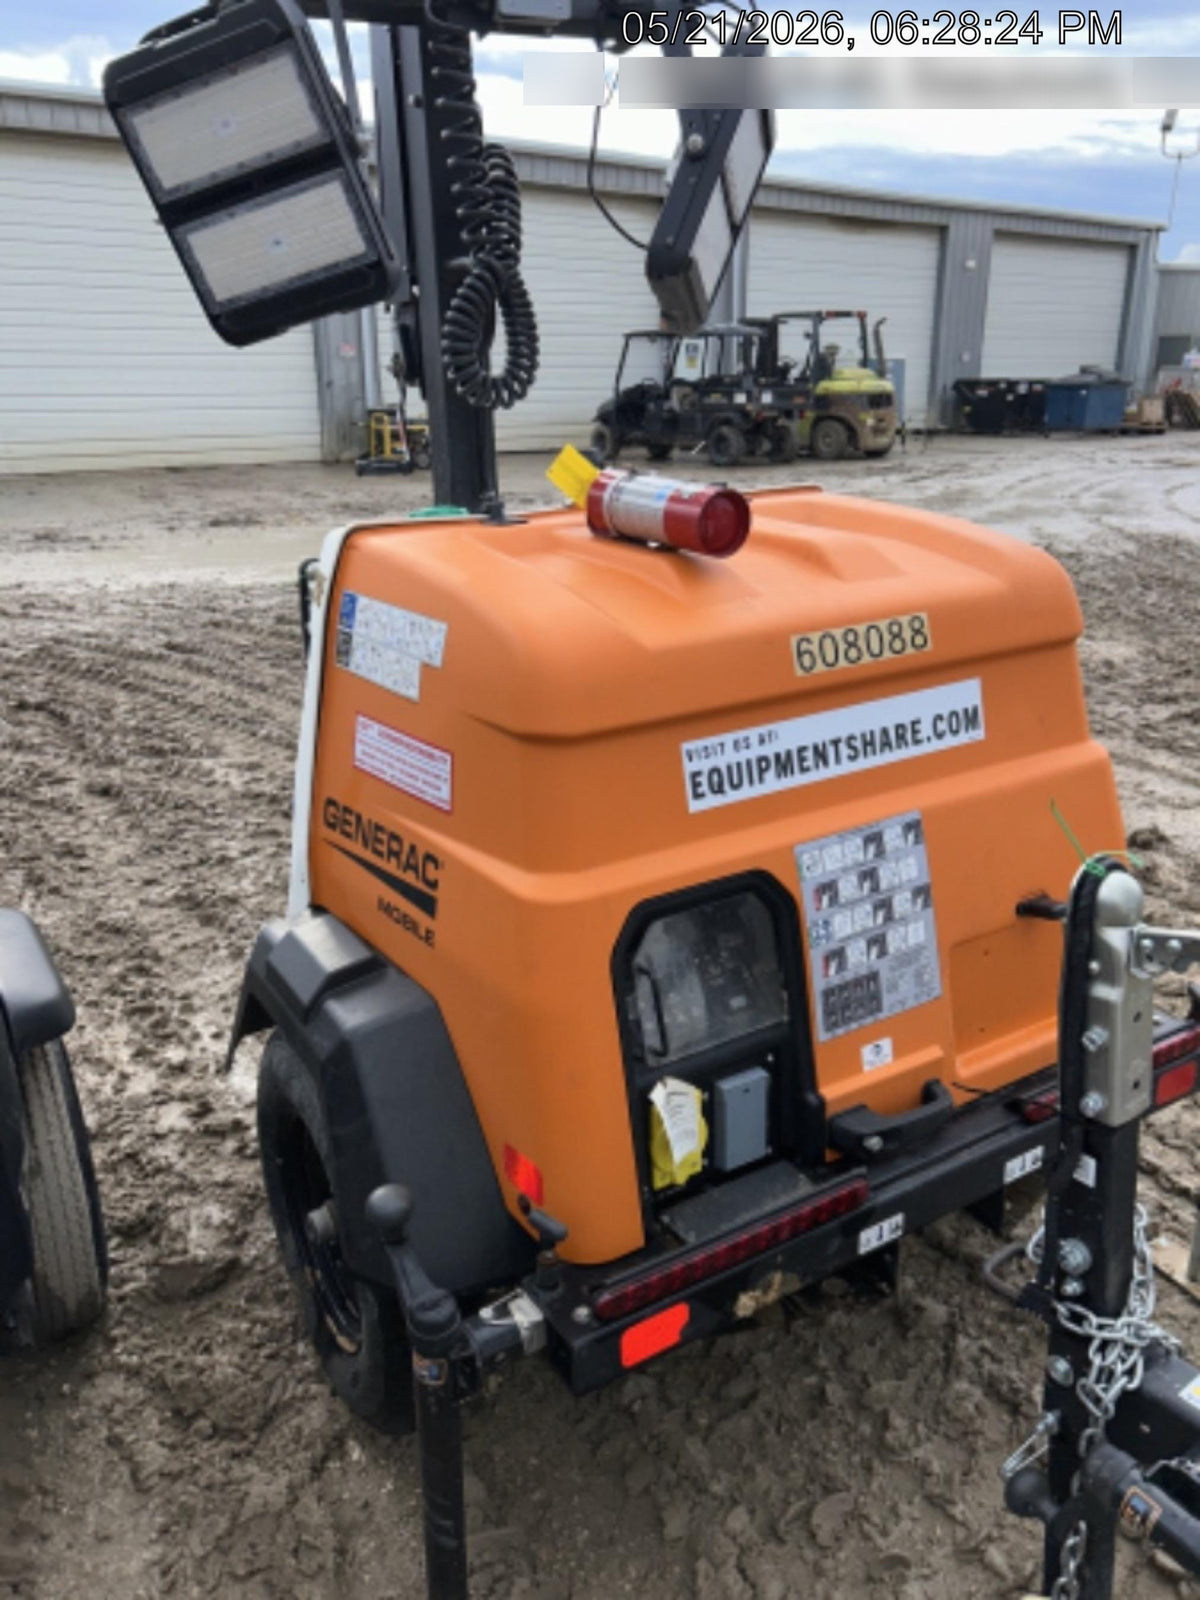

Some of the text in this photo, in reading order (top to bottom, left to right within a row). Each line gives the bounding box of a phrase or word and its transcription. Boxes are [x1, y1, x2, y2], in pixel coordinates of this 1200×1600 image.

[795, 615, 929, 673] 608088
[688, 704, 981, 801] EQUIPMENTSHARE.COM
[323, 797, 440, 891] GENERAC
[377, 896, 436, 949] MOBILE
